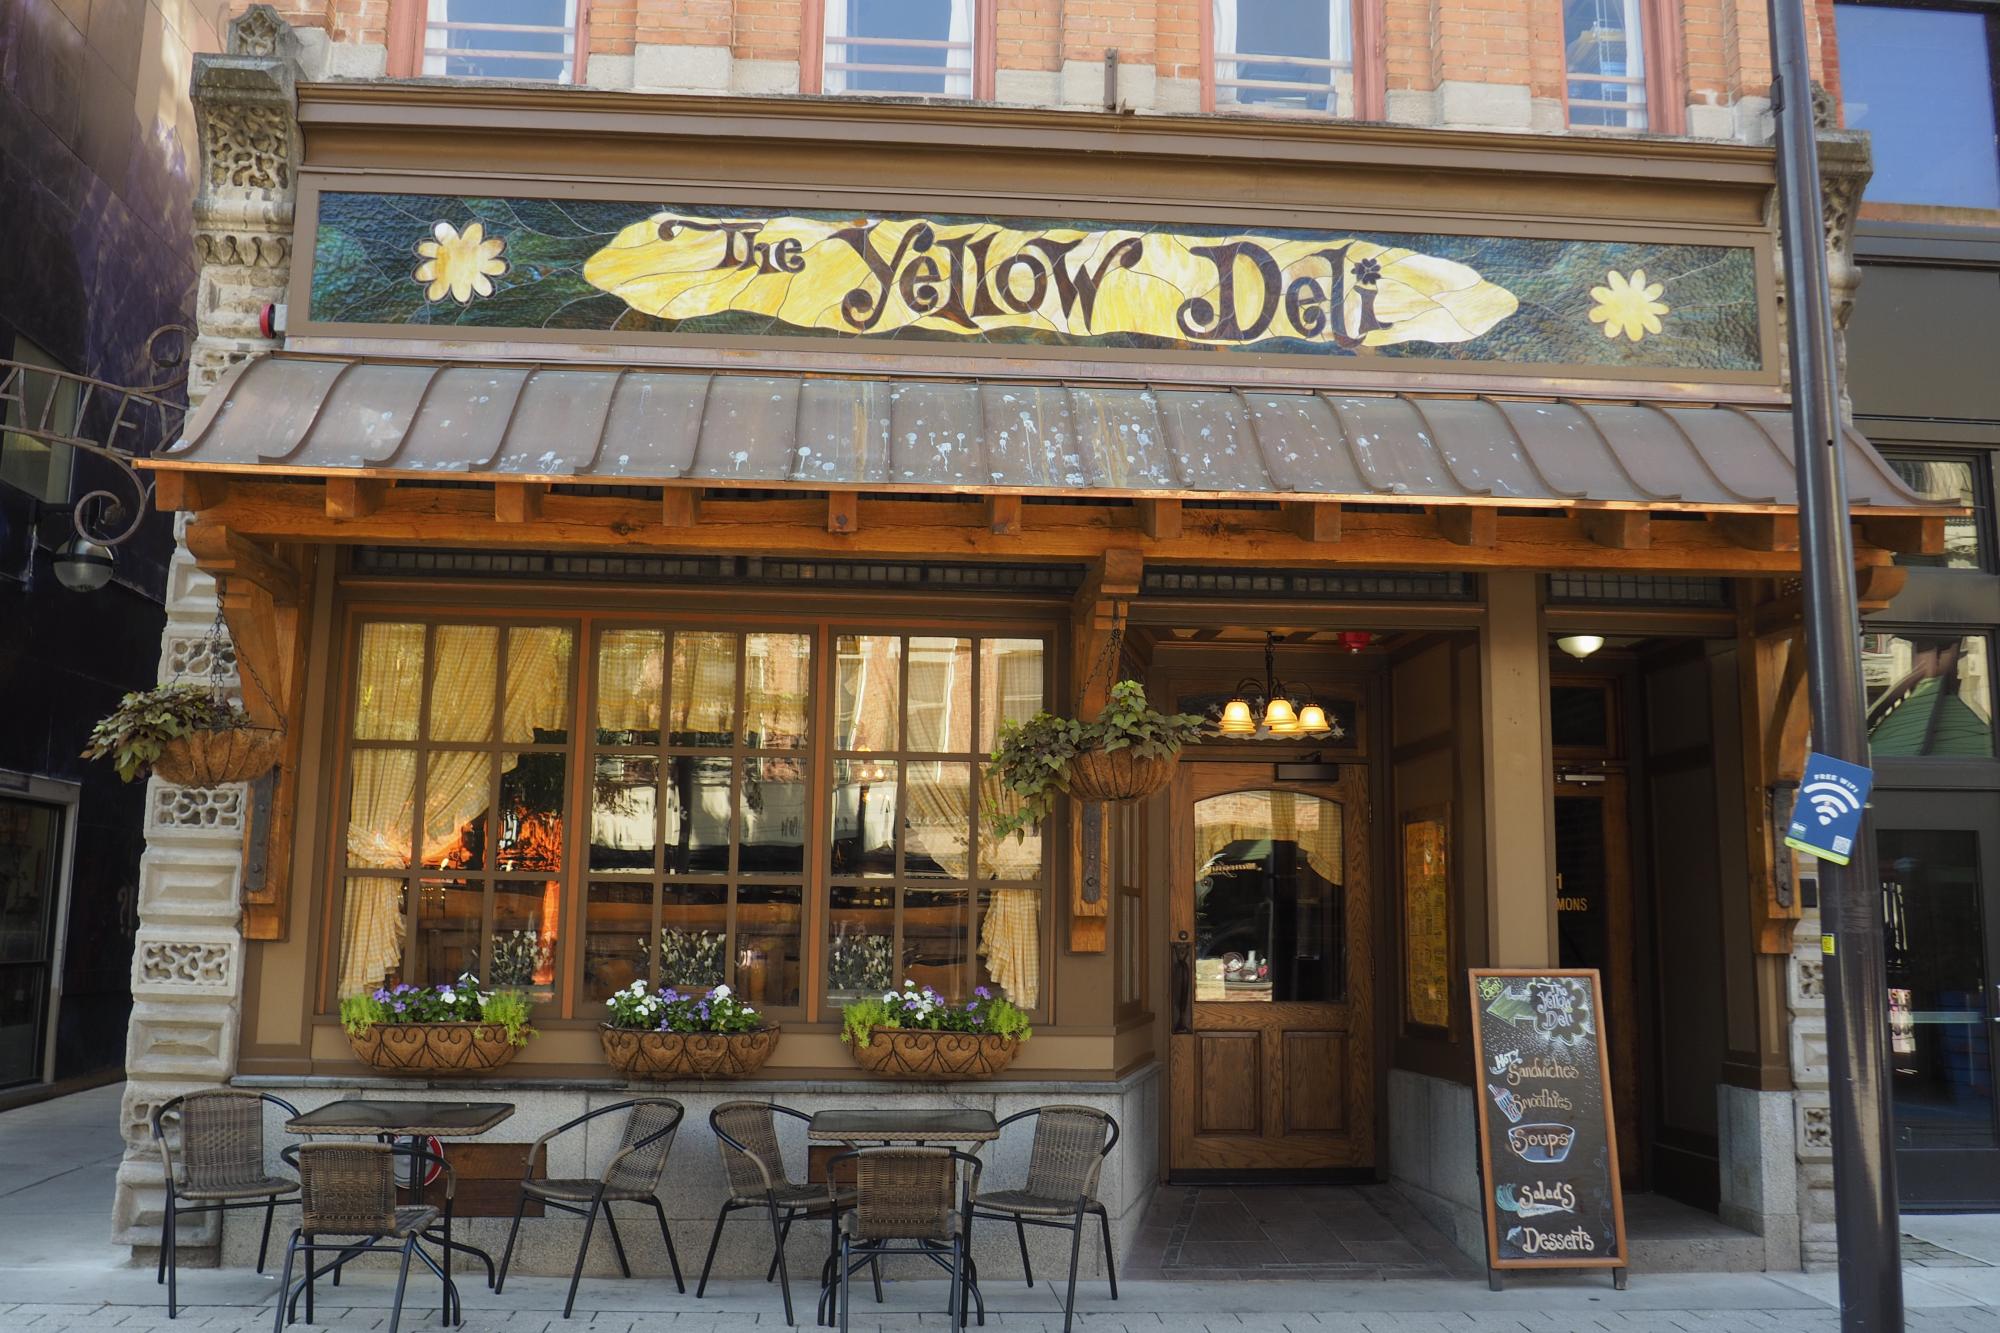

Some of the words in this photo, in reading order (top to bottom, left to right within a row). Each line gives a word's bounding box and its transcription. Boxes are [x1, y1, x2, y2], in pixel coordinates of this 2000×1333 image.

[657, 219, 806, 275] The
[1176, 241, 1394, 348] Deli
[1813, 773, 1838, 781] FREE
[1537, 982, 1567, 997] The
[1541, 1010, 1574, 1031] Deli
[1507, 1057, 1579, 1085] Sandwiches
[1511, 1088, 1573, 1115] Smoothies
[1512, 1129, 1568, 1156] Soups
[1522, 1226, 1595, 1253] Desserts
